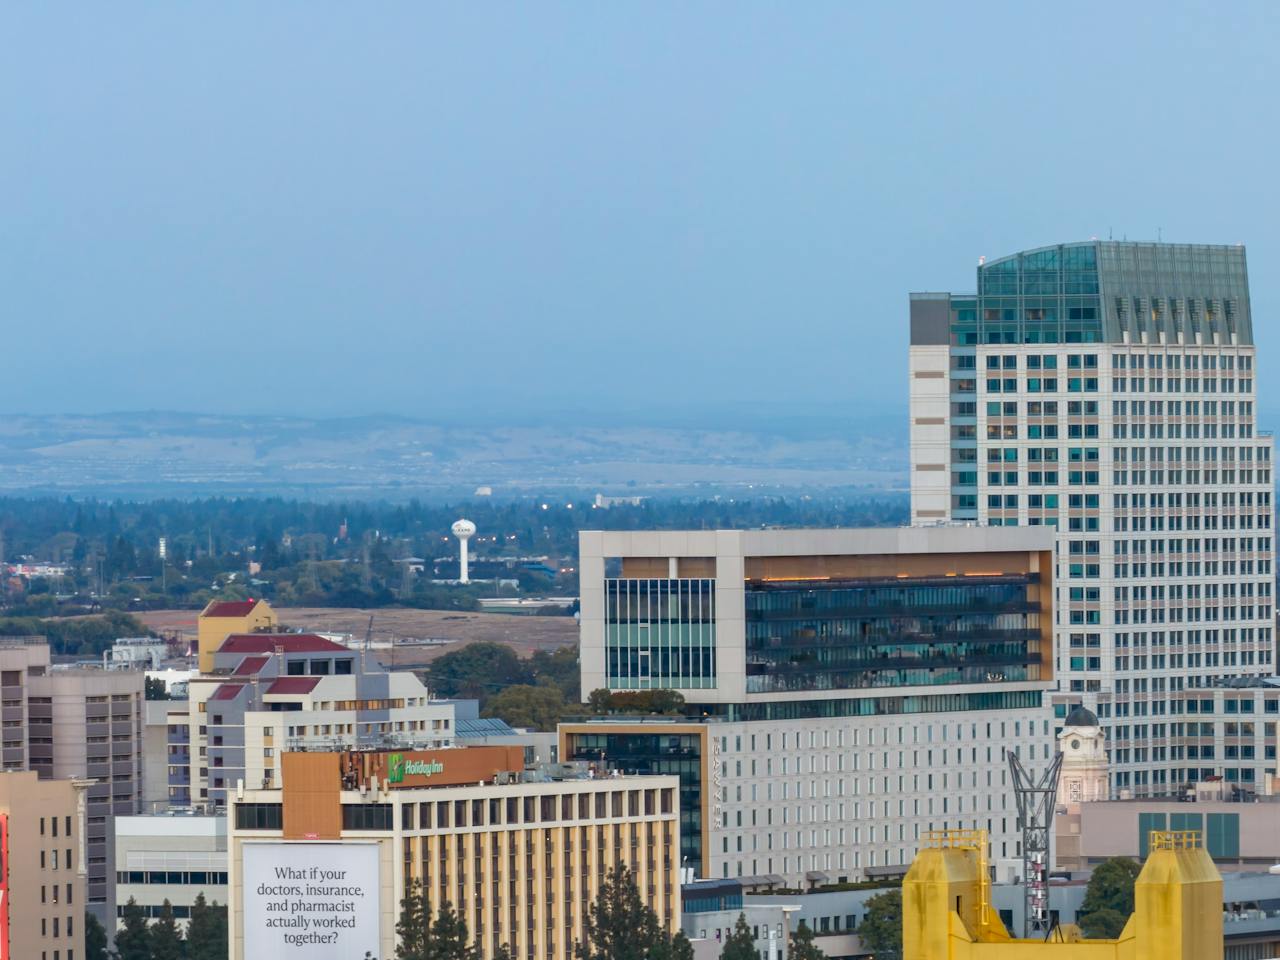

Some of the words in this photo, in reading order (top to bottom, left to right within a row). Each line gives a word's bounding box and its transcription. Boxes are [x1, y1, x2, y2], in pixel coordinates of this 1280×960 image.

[405, 760, 432, 777] Holiday
[432, 759, 443, 773] Inn
[713, 745, 721, 832] SAWYER
[274, 867, 307, 880] What
[310, 867, 319, 880] if
[320, 870, 347, 882] your
[257, 883, 304, 897] doctors,
[306, 883, 364, 898] insurance,
[266, 899, 288, 912] and
[291, 899, 355, 914] pharmacist
[266, 915, 311, 930] actually
[312, 916, 356, 928] worked
[284, 931, 339, 946] together?
